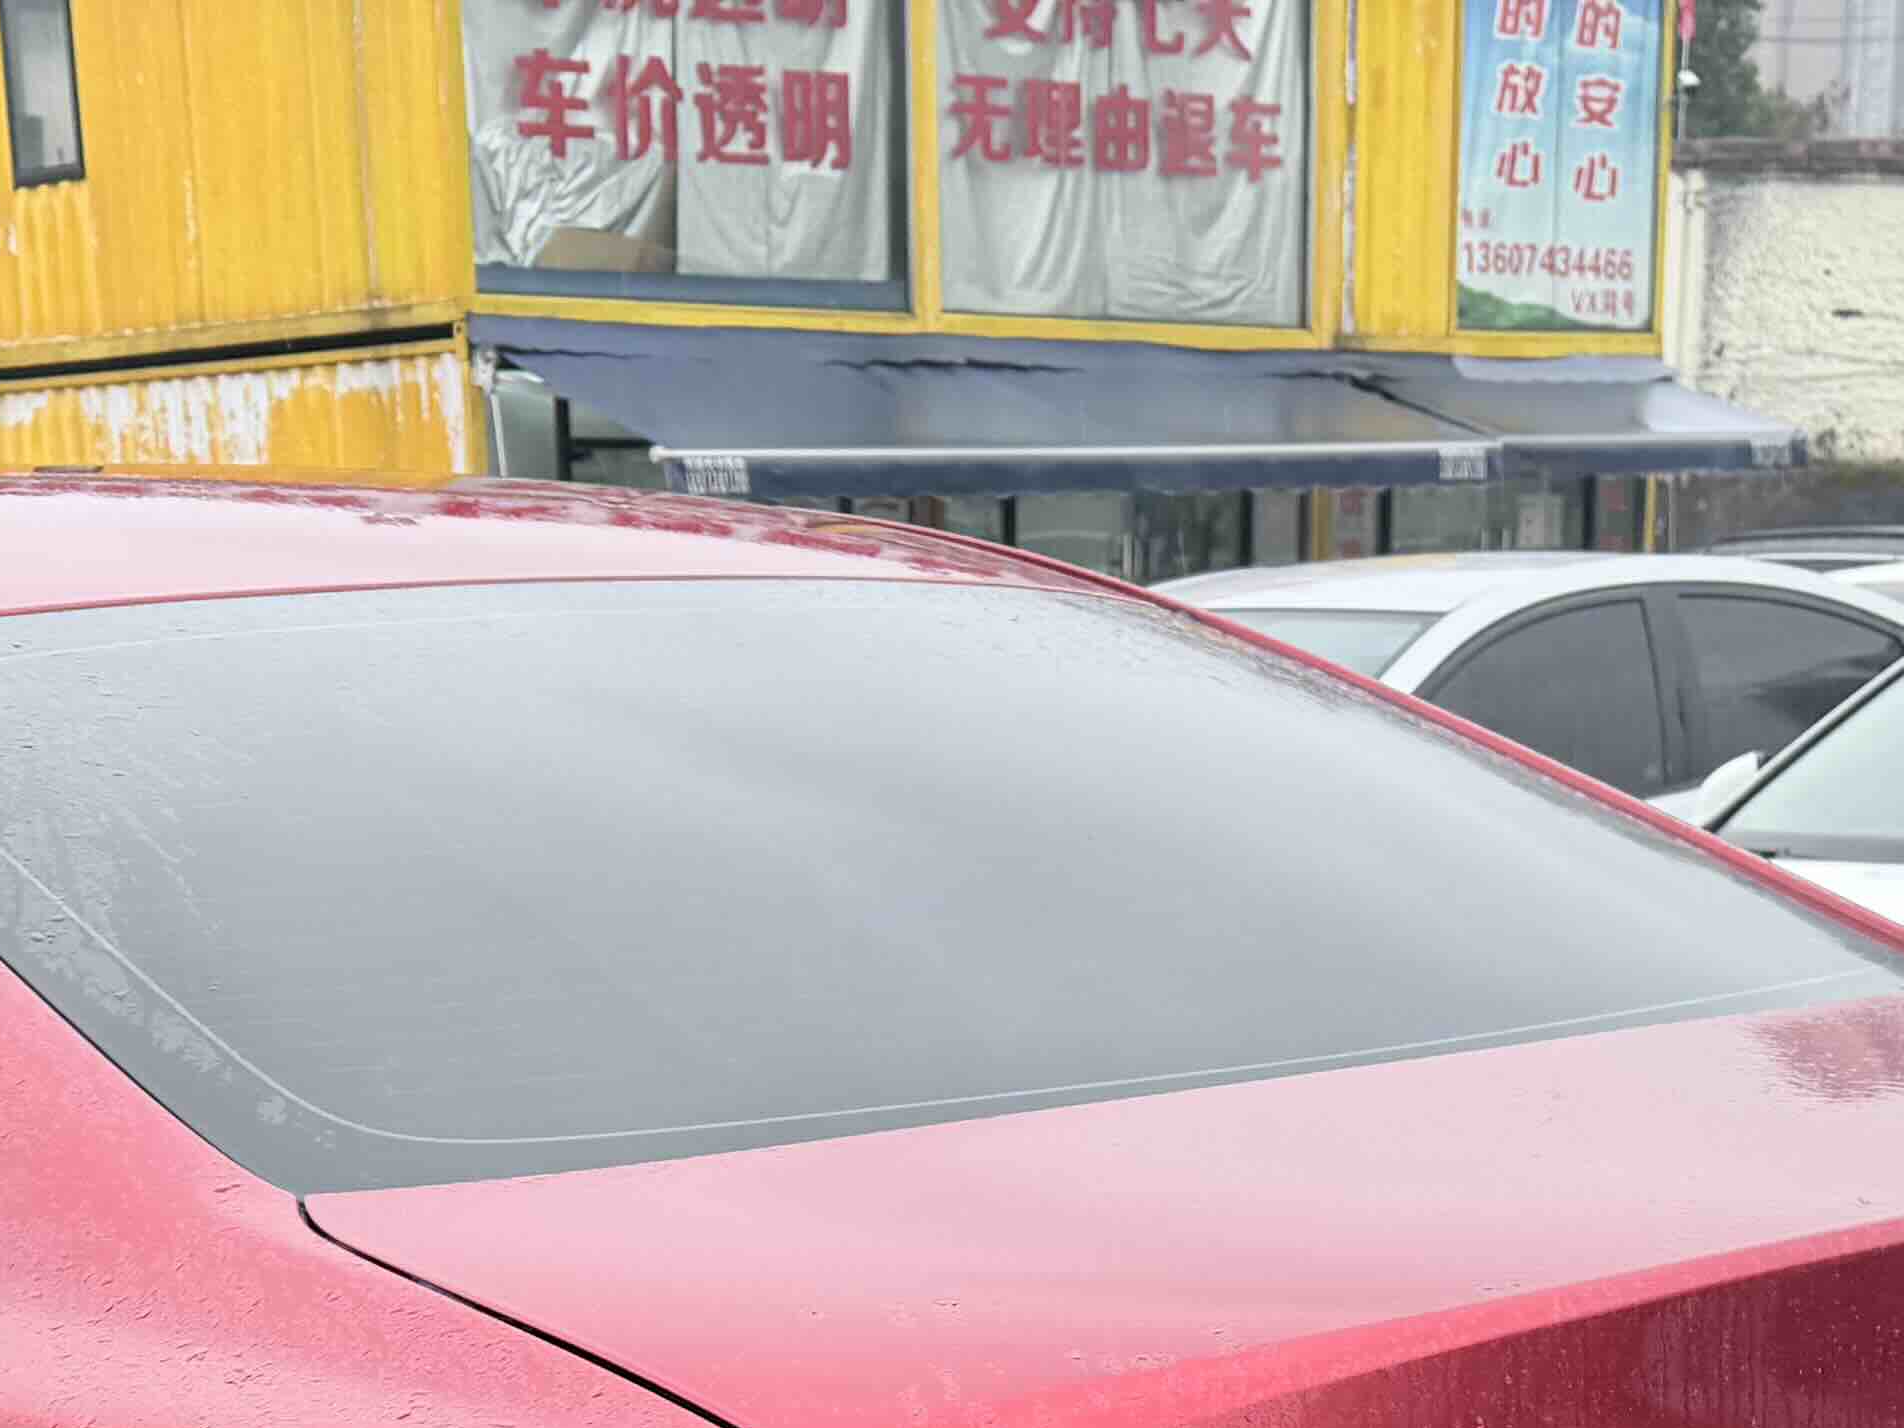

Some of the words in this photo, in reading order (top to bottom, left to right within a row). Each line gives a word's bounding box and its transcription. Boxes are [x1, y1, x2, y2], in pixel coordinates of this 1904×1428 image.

[514, 48, 852, 169] 车价透明
[948, 73, 1282, 183] 无理由退车
